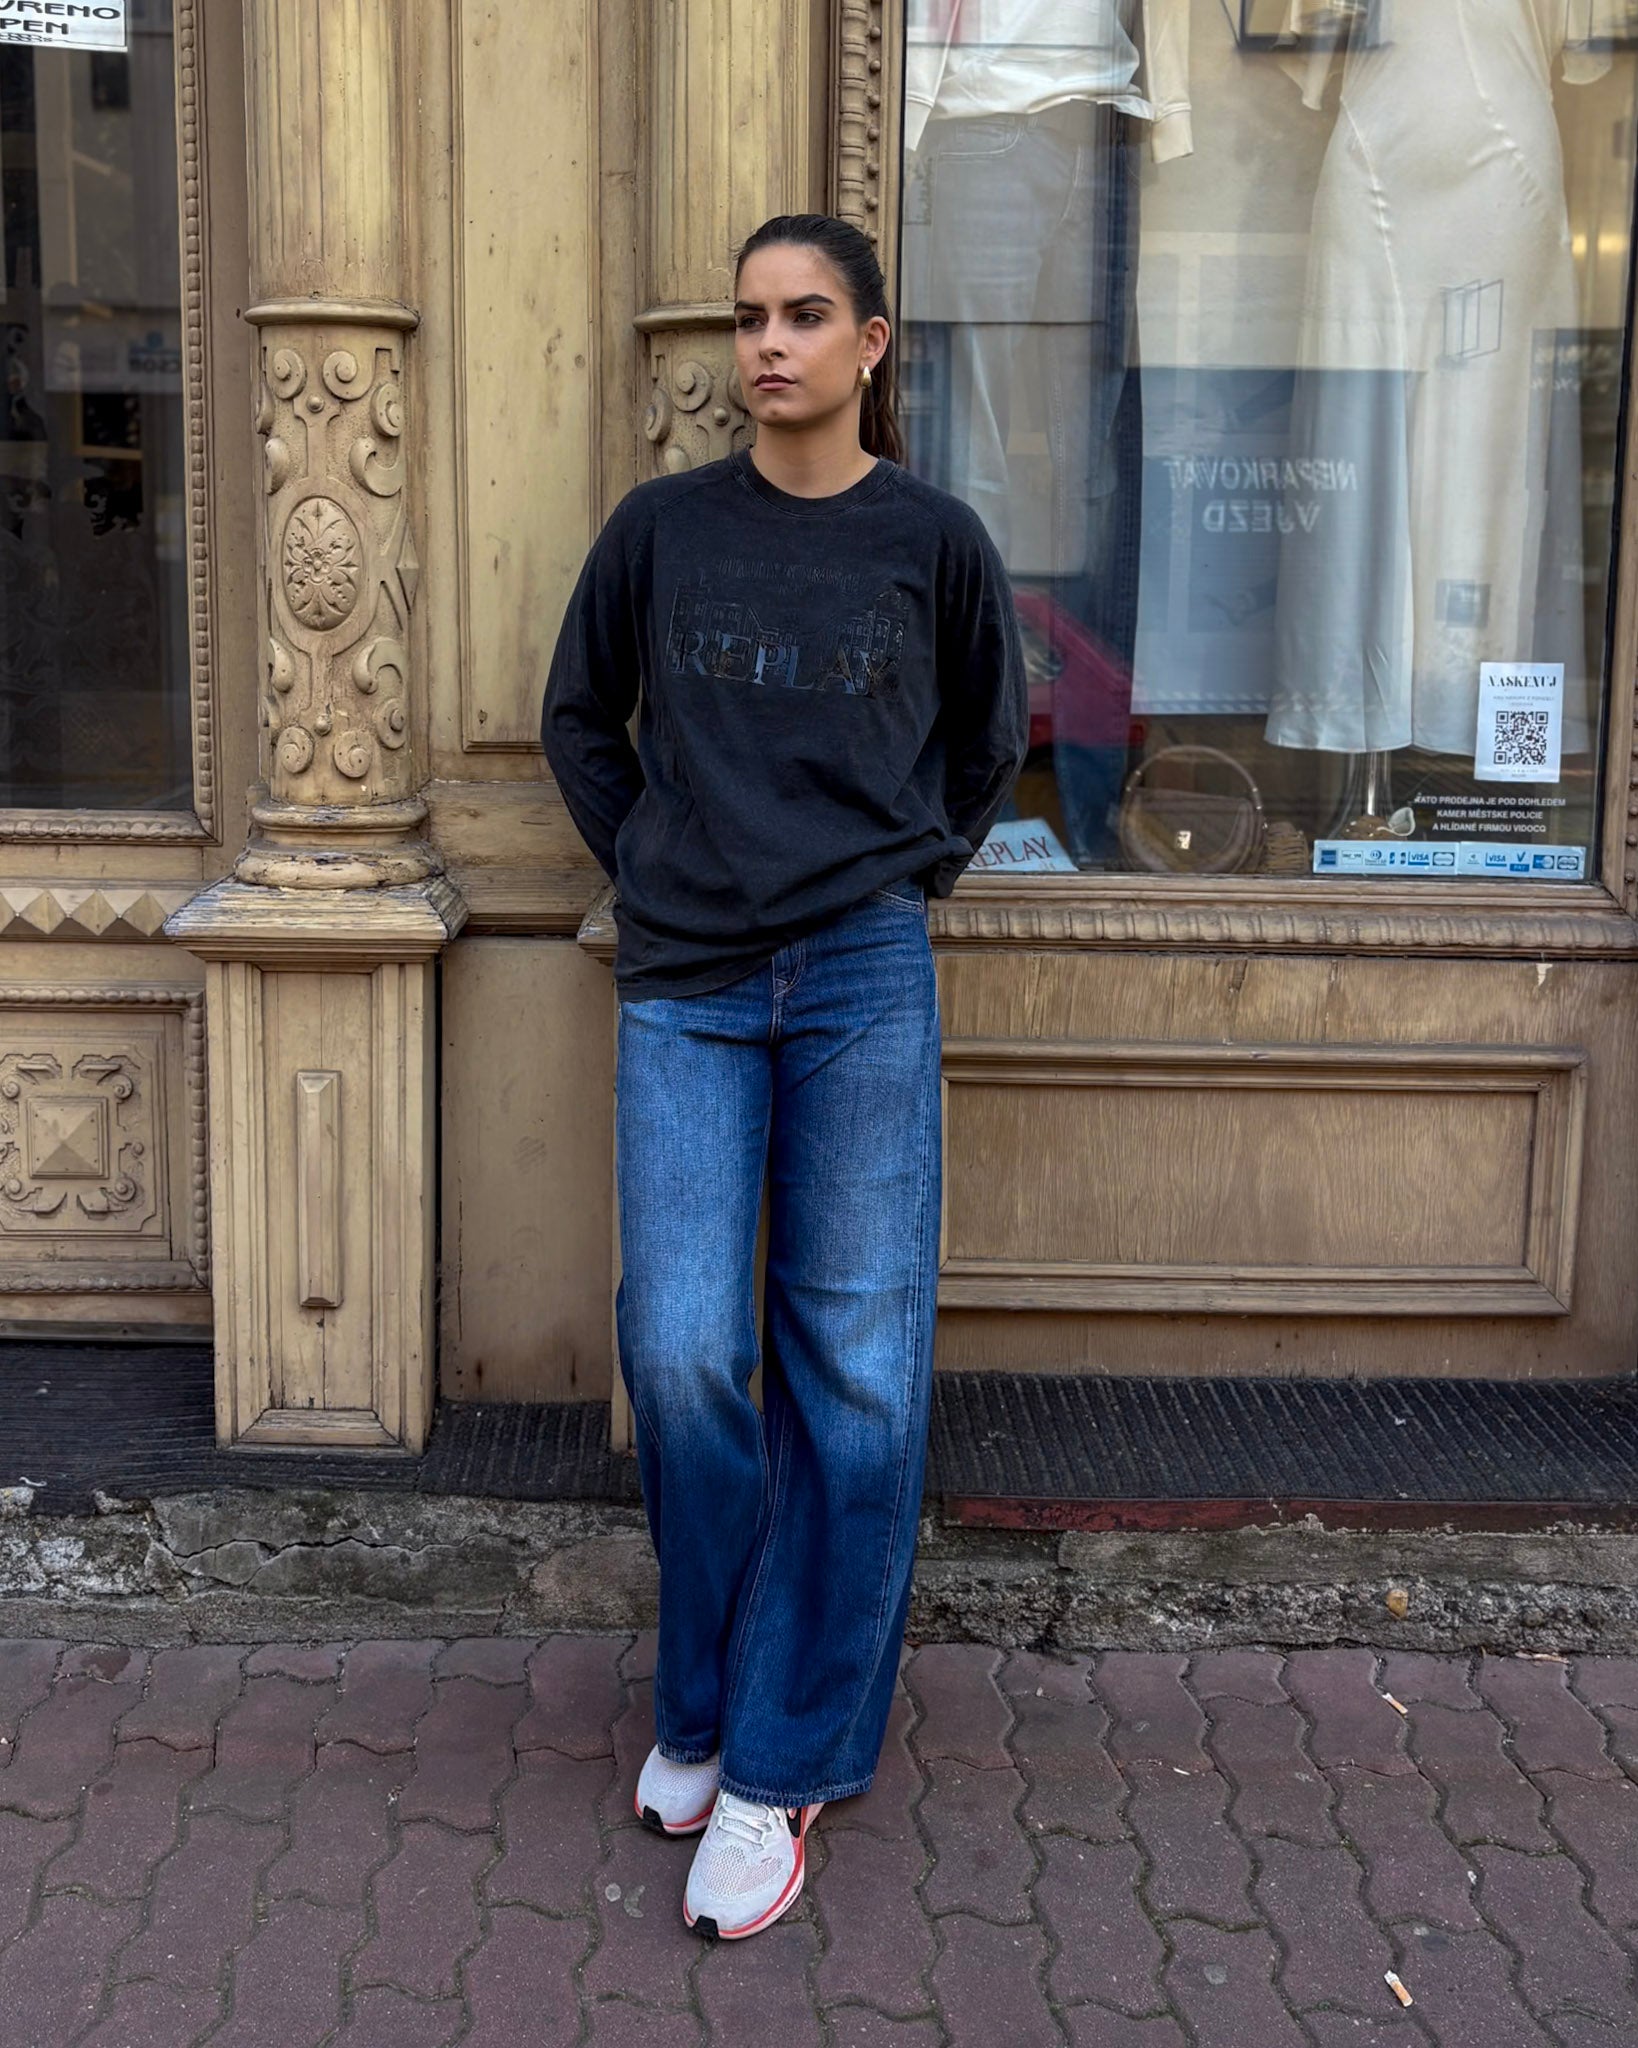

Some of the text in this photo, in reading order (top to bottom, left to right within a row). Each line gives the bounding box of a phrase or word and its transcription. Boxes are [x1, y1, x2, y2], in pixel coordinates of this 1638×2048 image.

[0, 17, 69, 35] PEN
[669, 630, 896, 696] REPLAY
[1439, 796, 1485, 806] PRODEJNA
[1486, 797, 1496, 806] JE
[1498, 797, 1516, 806] POD
[1518, 797, 1566, 807] DOHLEDEM
[1436, 809, 1467, 818] KAMER
[1510, 810, 1543, 819] POLICIE
[1432, 823, 1439, 831] A
[1478, 823, 1512, 832] FIRMOU
[1411, 853, 1429, 861] VISA
[1489, 855, 1506, 863] VISA
